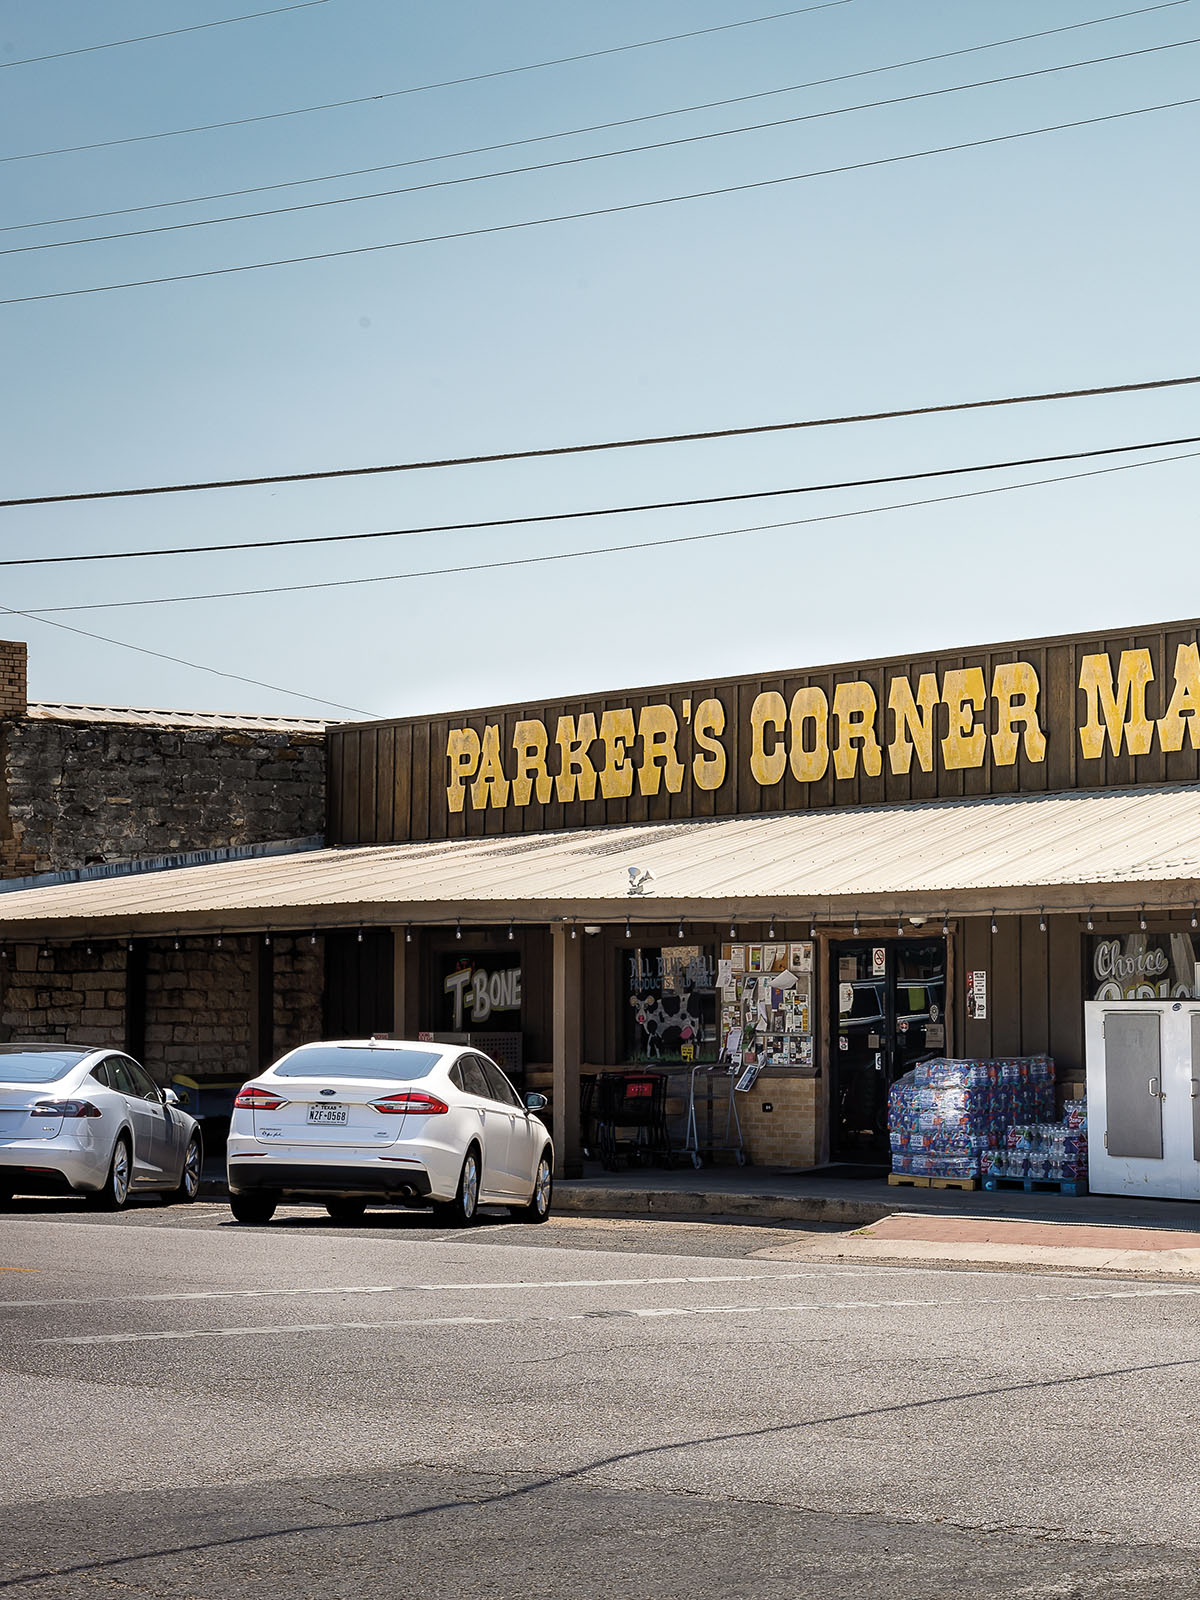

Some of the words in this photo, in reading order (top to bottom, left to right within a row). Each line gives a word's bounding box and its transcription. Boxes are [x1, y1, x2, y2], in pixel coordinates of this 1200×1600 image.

[446, 697, 727, 813] PARKER'S
[749, 661, 1047, 786] CORNER
[1095, 941, 1168, 981] Choice
[444, 967, 522, 1031] T-BONE
